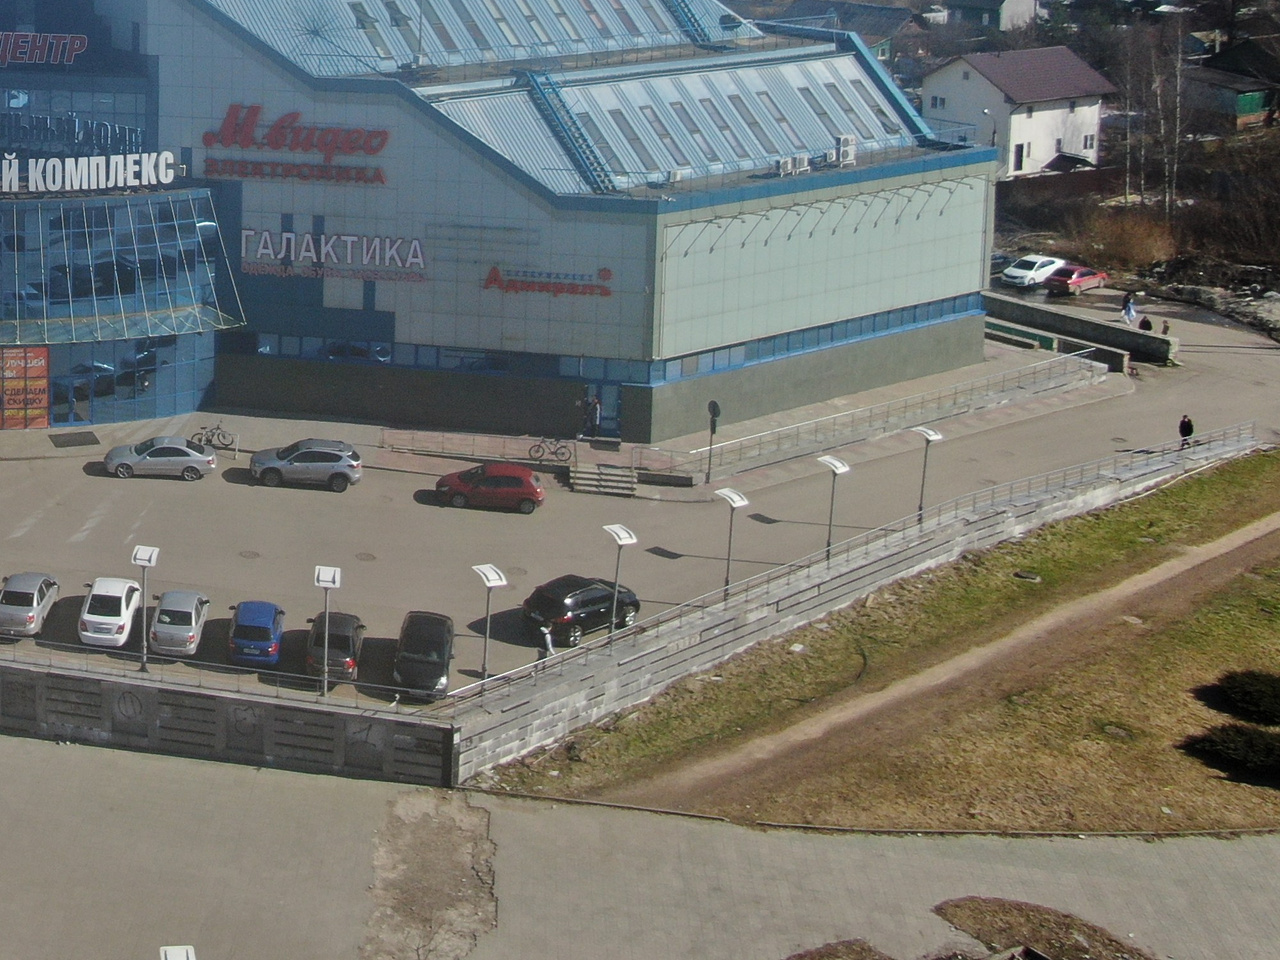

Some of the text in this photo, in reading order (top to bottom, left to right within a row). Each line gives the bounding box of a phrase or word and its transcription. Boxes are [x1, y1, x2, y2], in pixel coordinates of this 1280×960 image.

[28, 150, 175, 192] КОМПЛЕКС
[203, 158, 388, 185] ЭЛЕКТРОНИКА
[240, 229, 425, 269] ГАЛАКТИКА
[4, 387, 47, 396] СДЕЛАЕМ
